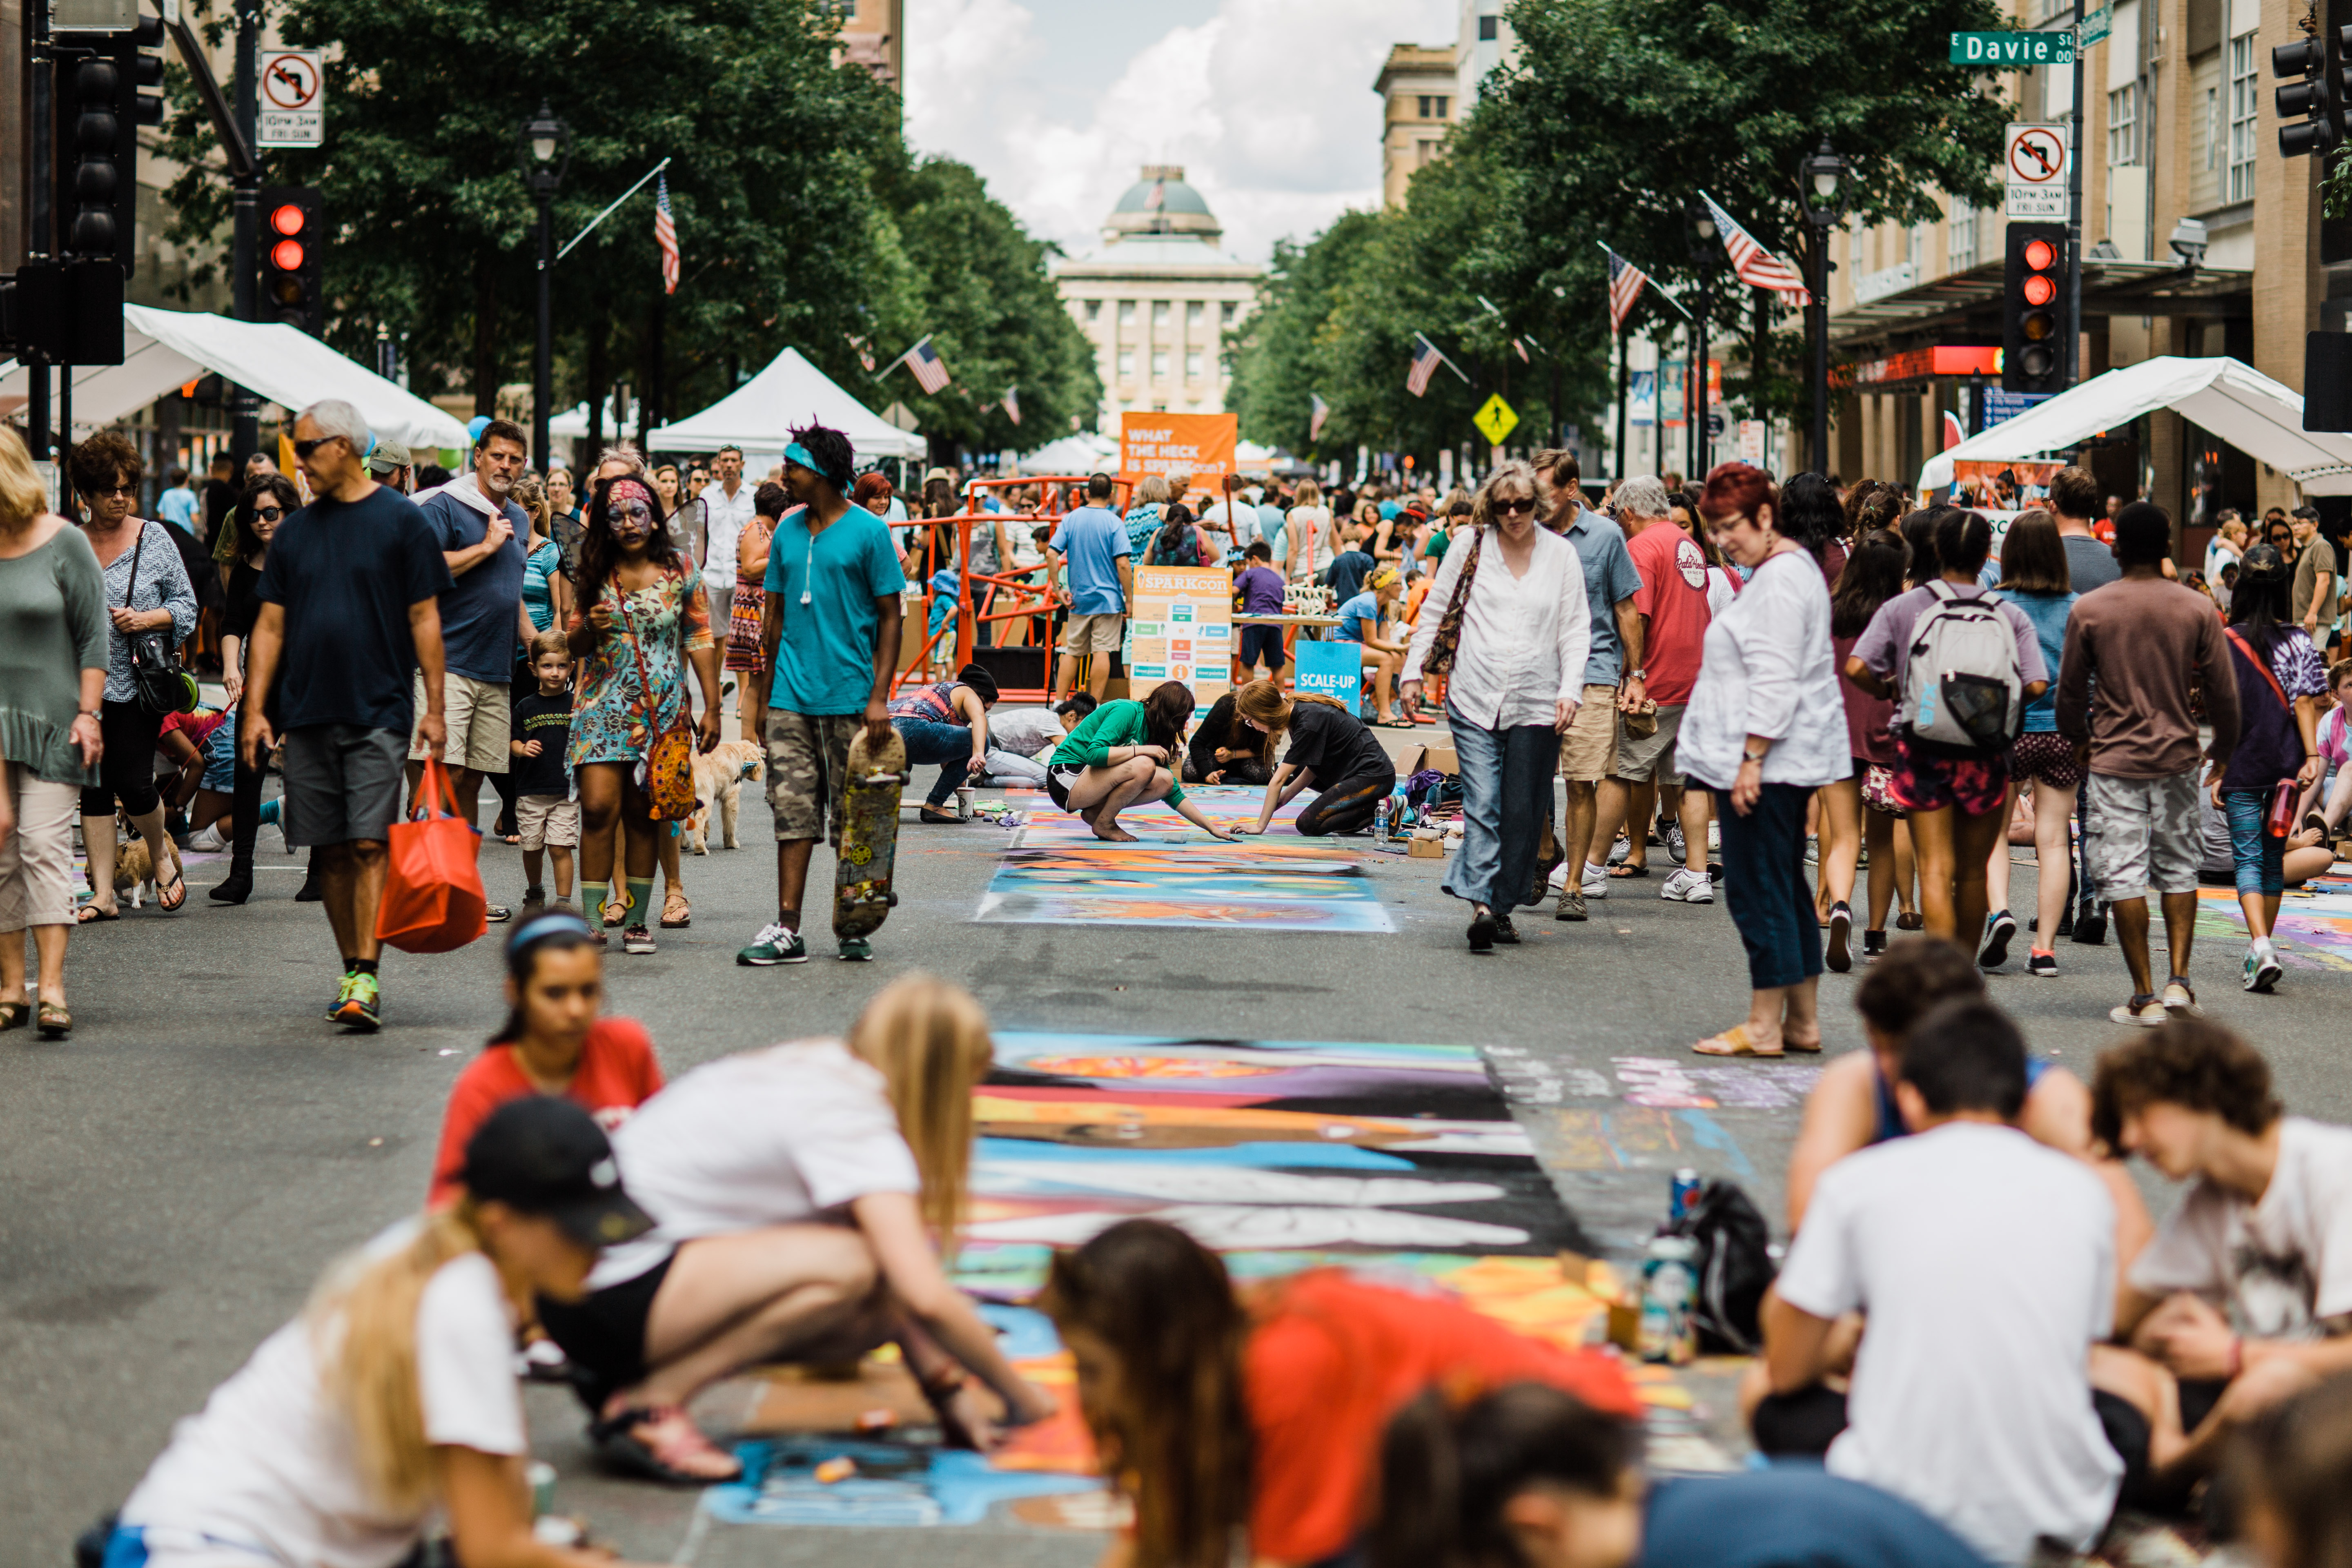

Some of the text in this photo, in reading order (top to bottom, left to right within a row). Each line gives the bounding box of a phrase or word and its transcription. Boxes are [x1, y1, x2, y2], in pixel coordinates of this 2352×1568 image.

[1951, 33, 2071, 60] E Davie St
[2056, 50, 2072, 62] 00
[1127, 430, 1173, 442] WHAT
[1127, 444, 1199, 458] THE HECK
[1127, 459, 1141, 472] IS
[1145, 577, 1227, 590] SPARKcon
[1301, 674, 1356, 688] SCALE-UP
